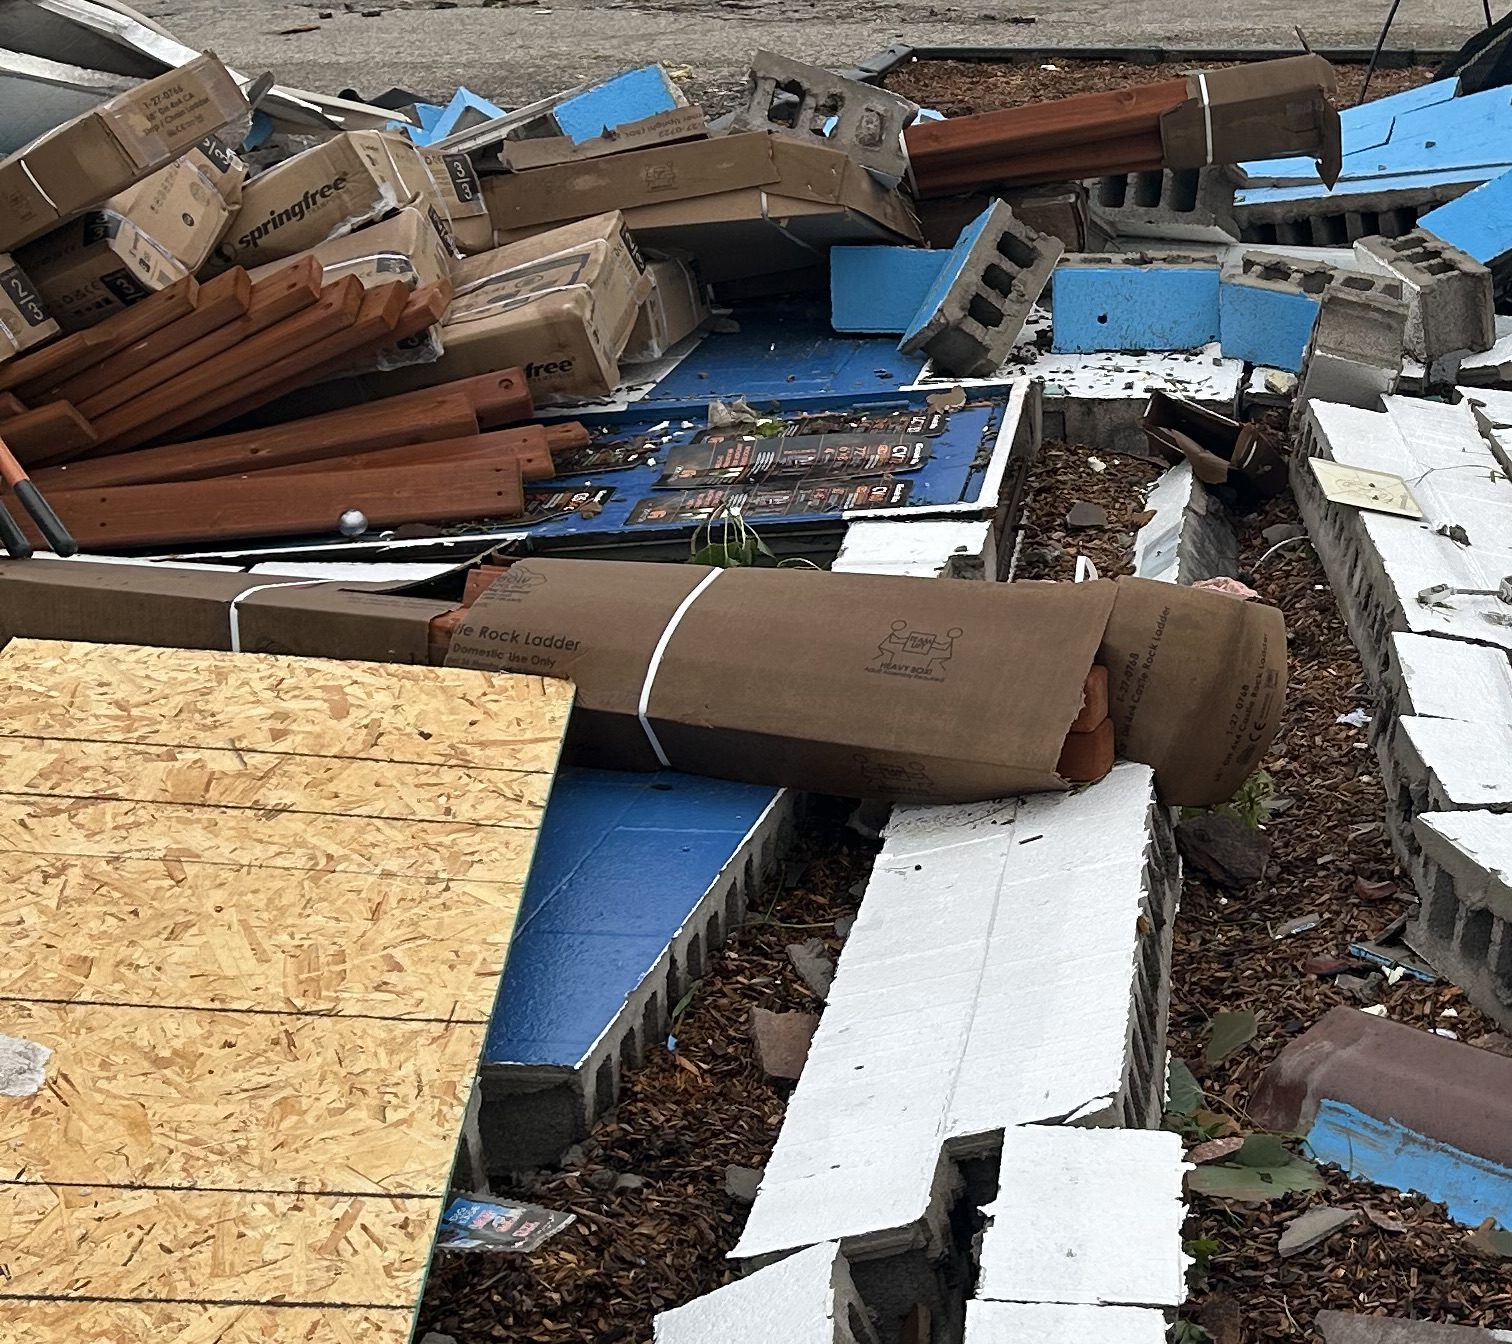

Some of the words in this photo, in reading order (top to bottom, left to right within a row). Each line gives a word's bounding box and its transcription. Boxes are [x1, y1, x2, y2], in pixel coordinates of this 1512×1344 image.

[453, 160, 474, 200] 3/3
[239, 175, 347, 250] springfree
[11, 278, 44, 320] 2/3
[453, 642, 503, 660] Domestic
[508, 647, 528, 665] Use
[531, 656, 556, 668] Only
[478, 624, 519, 645] Rock
[524, 631, 581, 652] Ladder
[1132, 671, 1149, 703] Castle
[1143, 643, 1159, 669] Rock
[1152, 606, 1171, 641] Ladder
[880, 662, 910, 673] HEAVY
